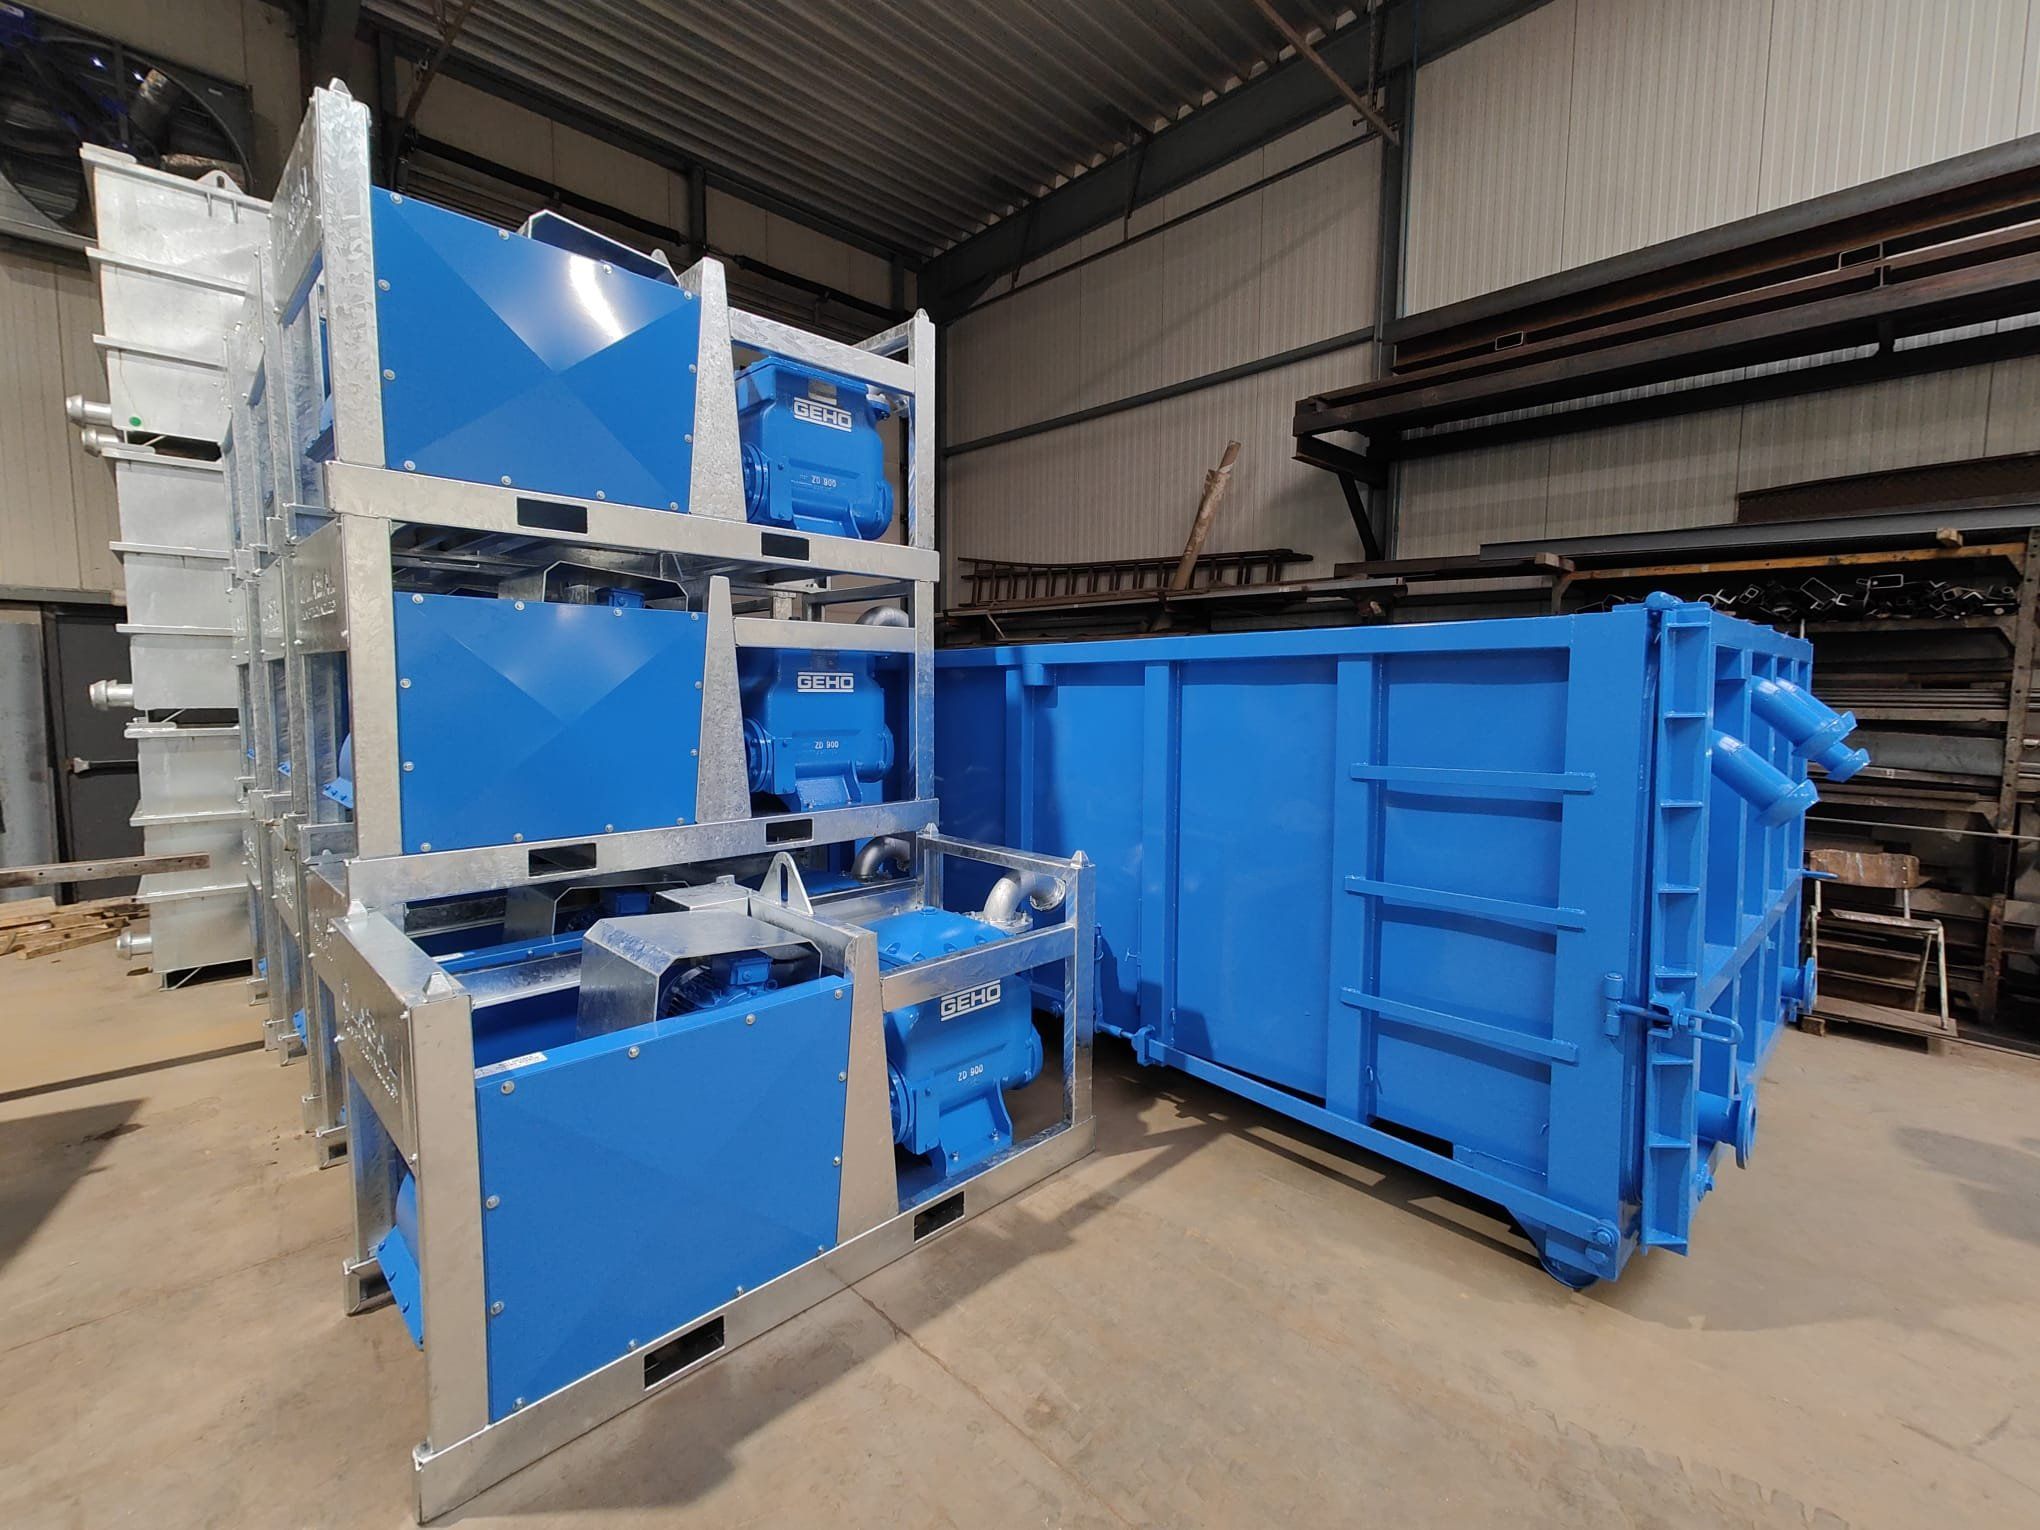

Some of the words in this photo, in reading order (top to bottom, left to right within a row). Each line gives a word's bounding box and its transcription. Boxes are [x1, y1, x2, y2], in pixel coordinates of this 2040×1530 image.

[793, 401, 852, 428] GEHO
[797, 675, 854, 689] GEHO
[940, 983, 1001, 1018] GEHO
[958, 1070, 967, 1081] ZD
[970, 1064, 983, 1076] 900
